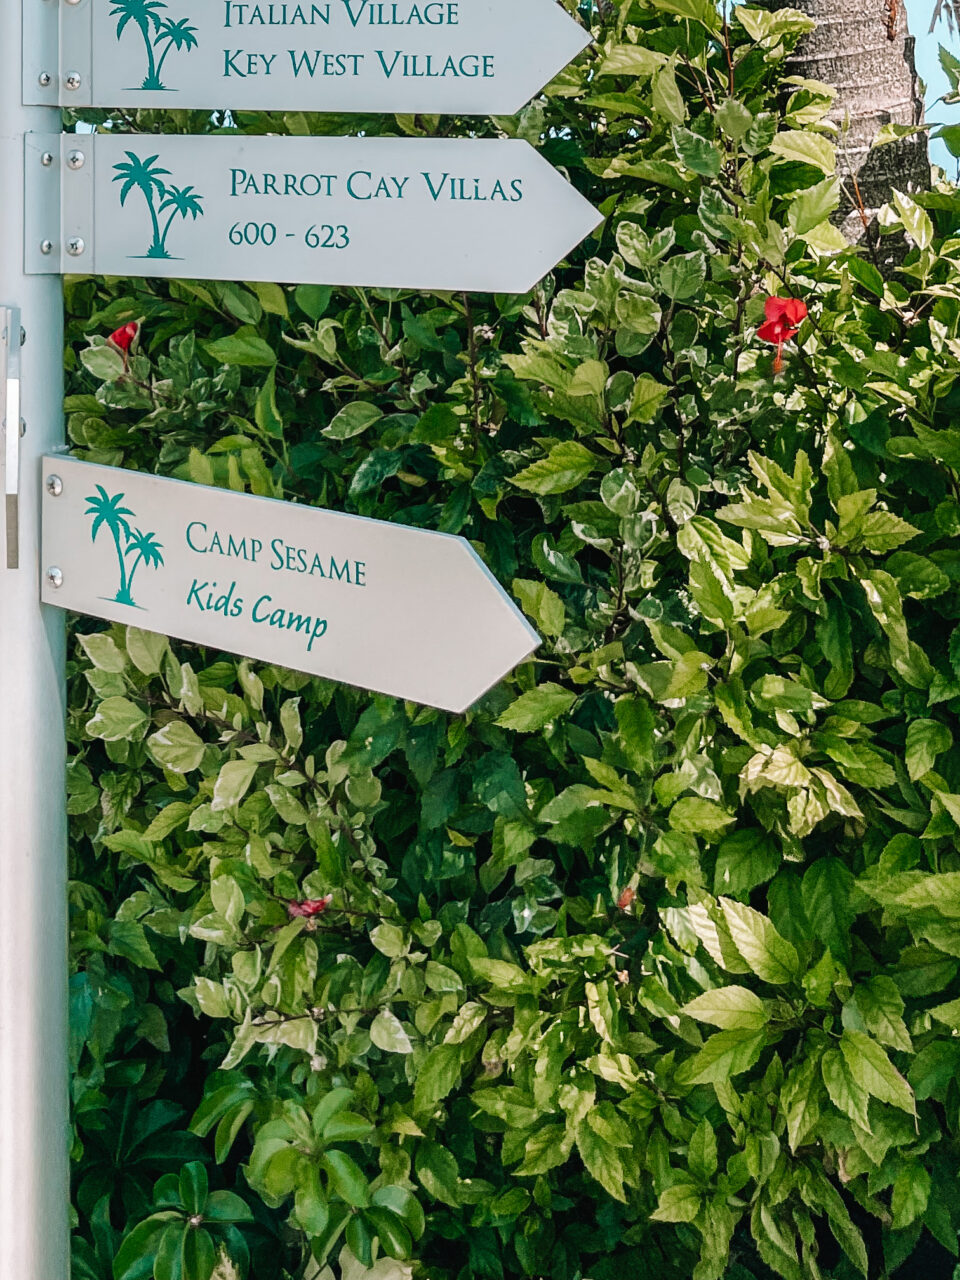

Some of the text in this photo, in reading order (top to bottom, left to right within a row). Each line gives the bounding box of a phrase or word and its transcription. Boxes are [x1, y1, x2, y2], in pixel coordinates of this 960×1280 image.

[223, 0, 459, 28] ITALIAN VILLAGE
[223, 49, 495, 79] KEY WEST VILLAGE
[229, 168, 523, 202] PARROT CAY VILLAS
[228, 222, 277, 246] 600
[304, 224, 350, 249] 623
[185, 521, 366, 587] CAMP SESAME
[186, 579, 328, 652] Kids Camp
